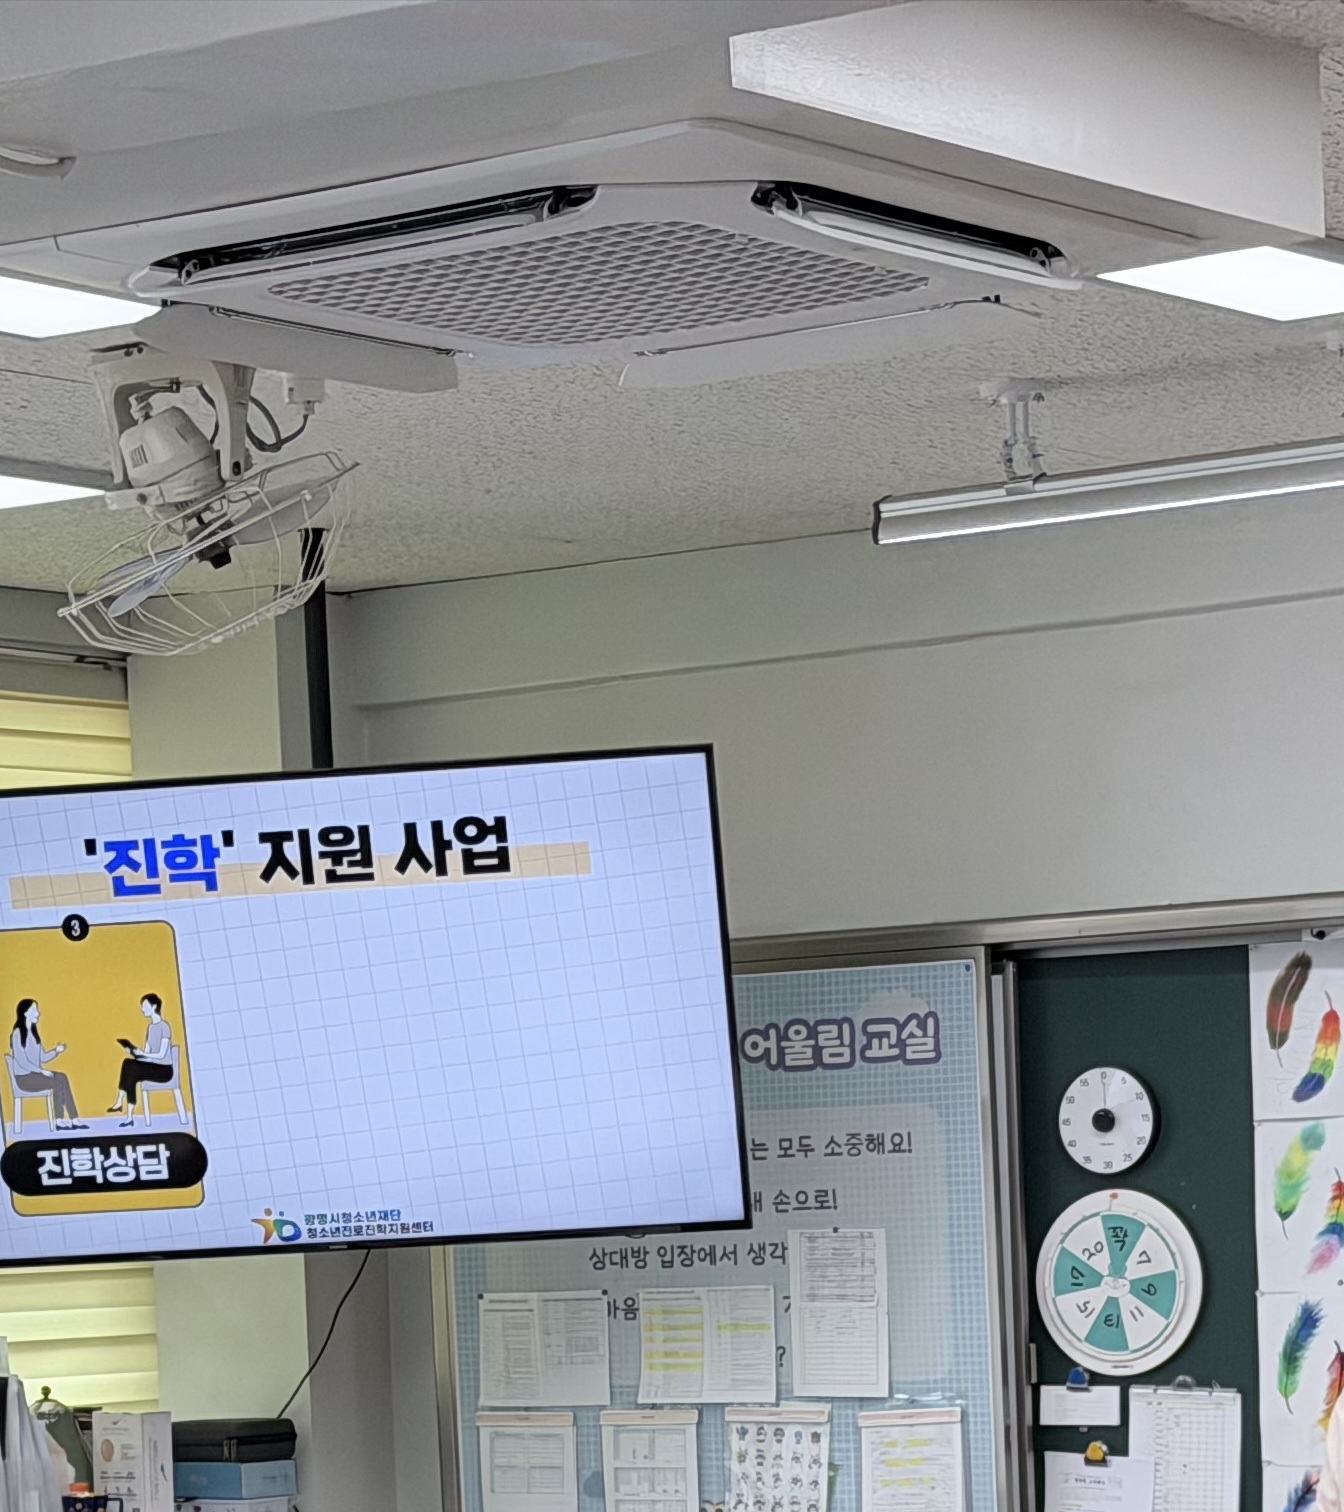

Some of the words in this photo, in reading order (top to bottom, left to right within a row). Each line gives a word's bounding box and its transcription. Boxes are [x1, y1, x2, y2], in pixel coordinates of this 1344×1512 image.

[84, 829, 235, 897] '진학'
[258, 824, 376, 886] 지원
[394, 815, 512, 878] 사업
[71, 919, 81, 937] 3
[742, 1017, 855, 1070] 어울림
[862, 1013, 940, 1064] 교실
[1100, 1071, 1108, 1080] 0
[1079, 1078, 1089, 1087] 55
[1065, 1095, 1075, 1104] 50
[1135, 1091, 1144, 1101] 10
[1061, 1118, 1071, 1126] 45
[1141, 1113, 1151, 1122] 15
[776, 1134, 816, 1160] 모두
[823, 1131, 913, 1158] 소중해요!
[1067, 1140, 1077, 1148] 40
[1136, 1136, 1146, 1145] 20
[1082, 1155, 1093, 1164] 35
[1123, 1153, 1133, 1162] 25
[37, 1143, 171, 1187] 진학상담
[1103, 1161, 1113, 1170] 30
[772, 1188, 839, 1214] 손으로!
[589, 1246, 650, 1271] 상대방
[657, 1243, 738, 1269] 입장에서
[1082, 1240, 1105, 1261] 20
[1070, 1265, 1086, 1287] 17
[1076, 1300, 1096, 1319] 15
[1103, 1313, 1120, 1329] 13
